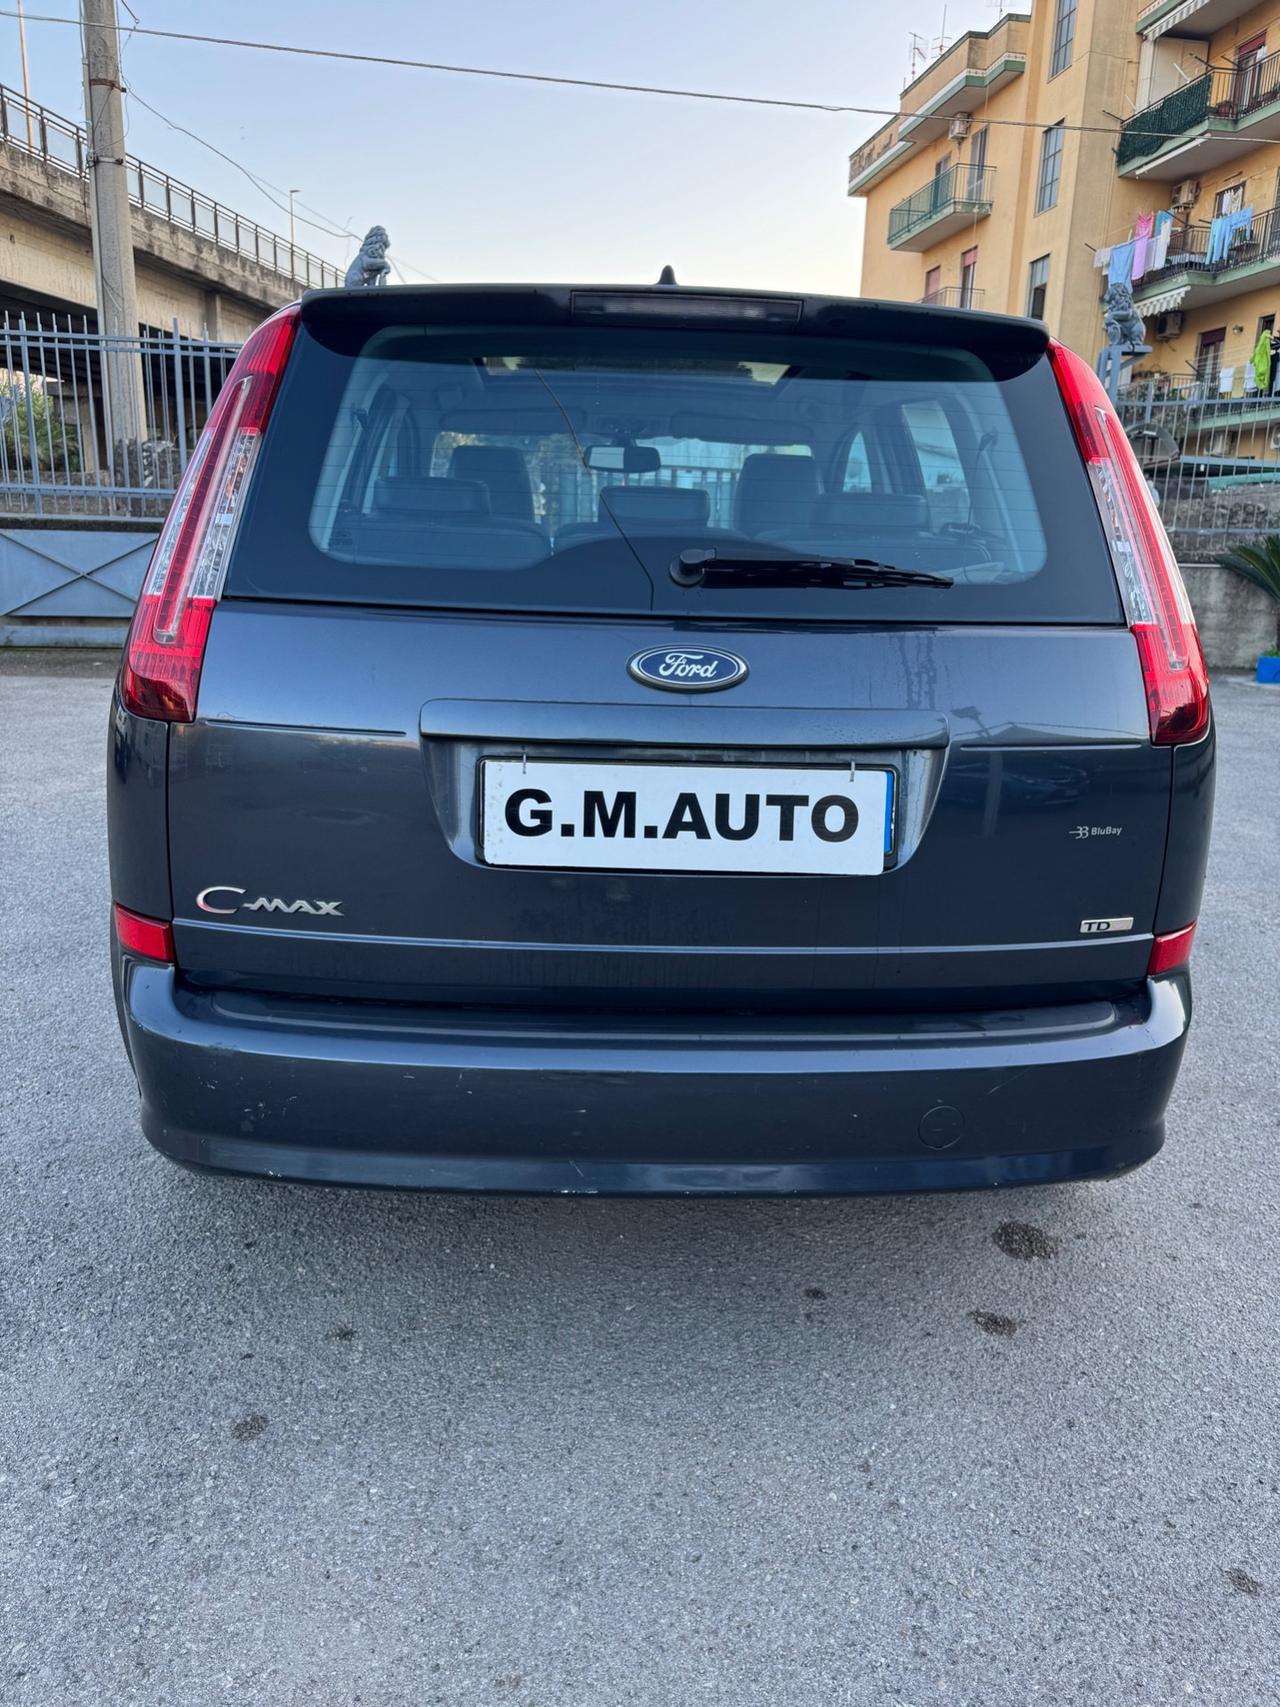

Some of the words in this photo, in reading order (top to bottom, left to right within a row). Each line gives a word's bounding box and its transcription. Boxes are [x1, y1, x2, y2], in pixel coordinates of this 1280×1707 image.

[659, 653, 718, 677] Ford
[505, 788, 860, 842] G.M.AUTO
[1091, 826, 1122, 836] BluBay
[196, 886, 344, 916] C-MAX
